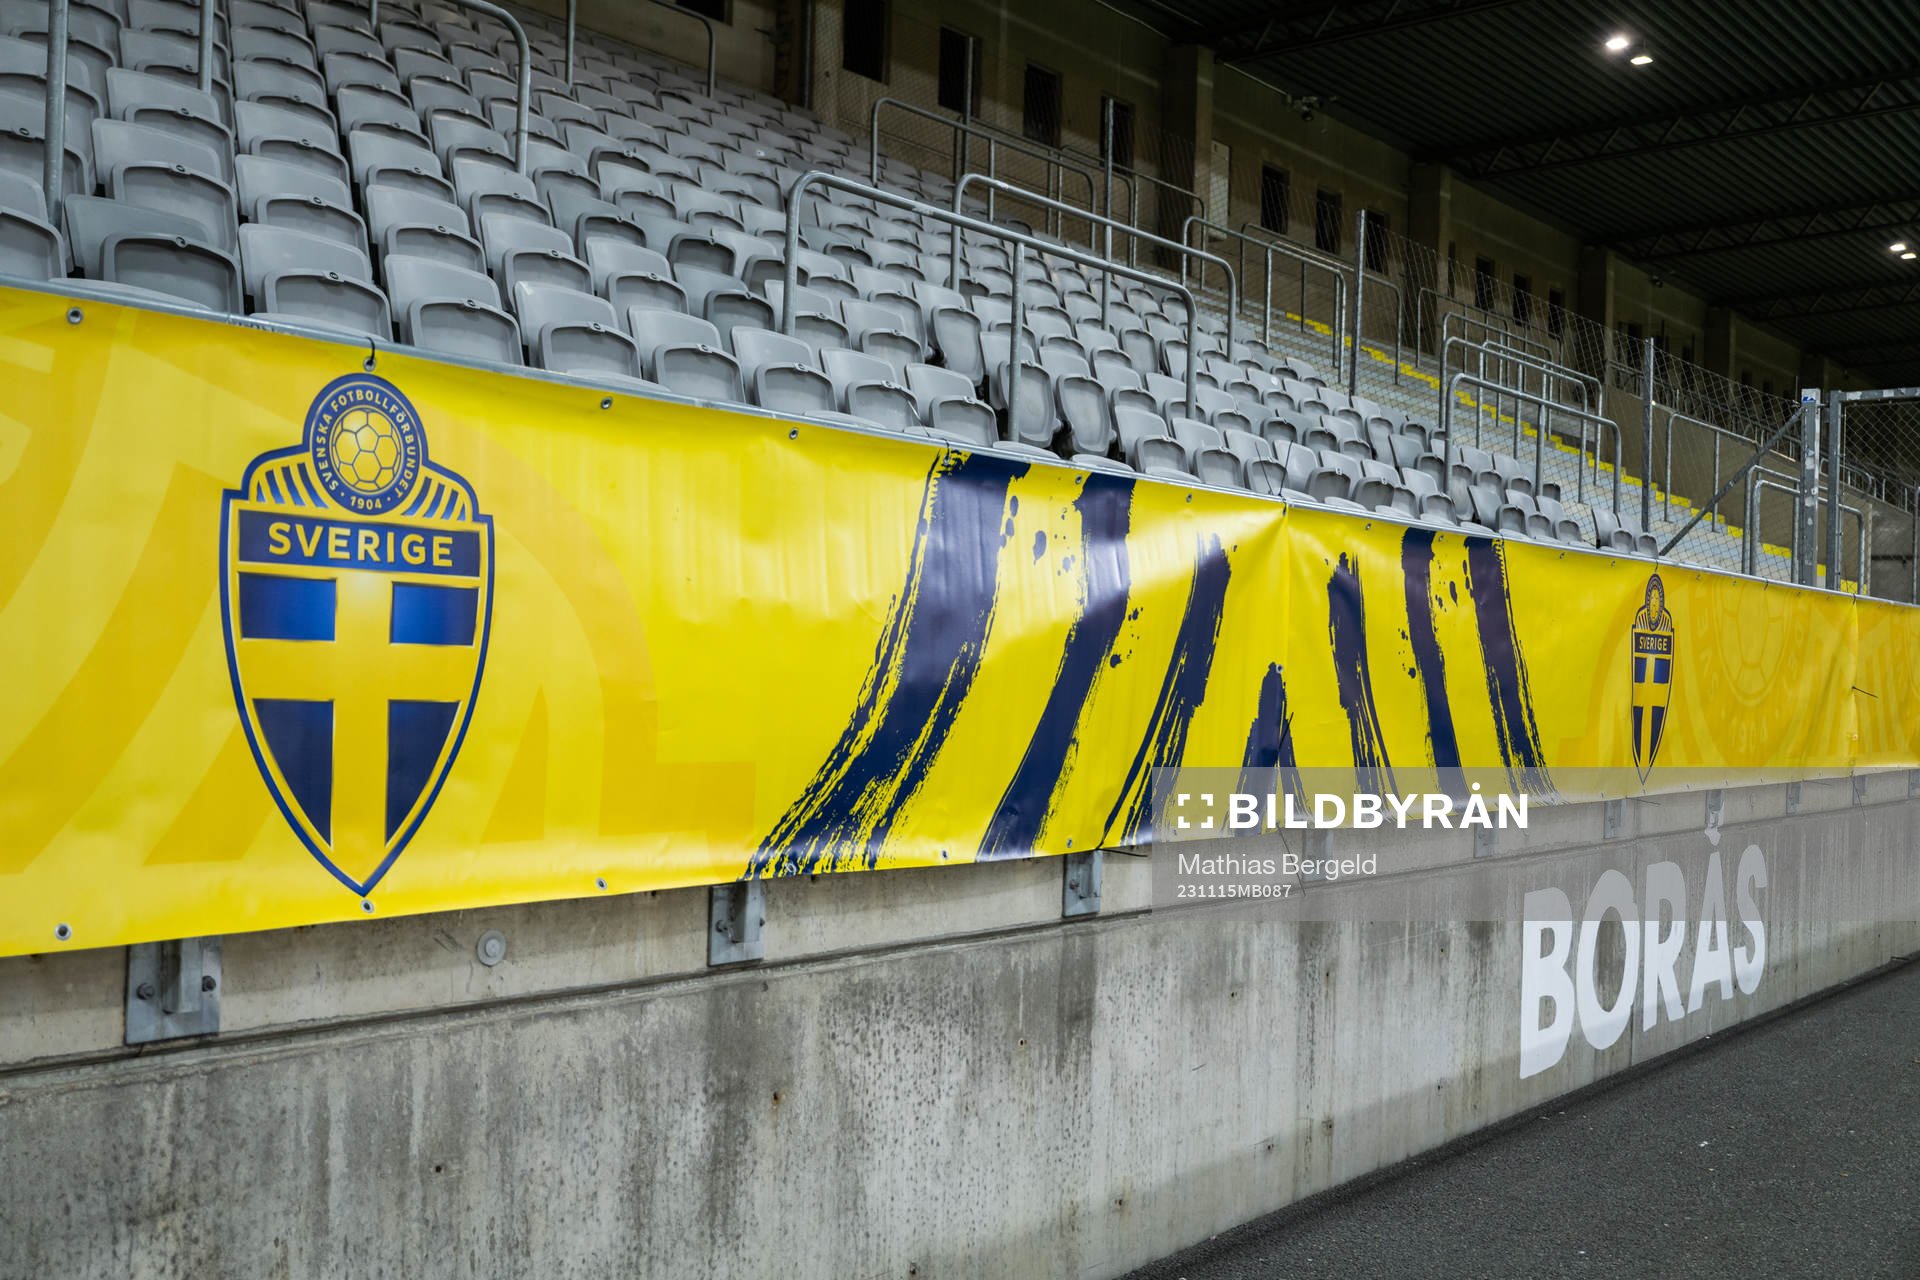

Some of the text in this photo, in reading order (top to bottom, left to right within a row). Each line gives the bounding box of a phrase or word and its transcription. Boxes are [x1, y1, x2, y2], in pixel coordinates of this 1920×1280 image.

[316, 388, 417, 499] SVENSKA FOTBOLLFÖRBUNDET
[350, 496, 382, 510] 1904
[268, 521, 454, 567] SVERIGE
[1639, 636, 1668, 652] SVERIGE
[1520, 802, 1767, 1079] BORÅS
